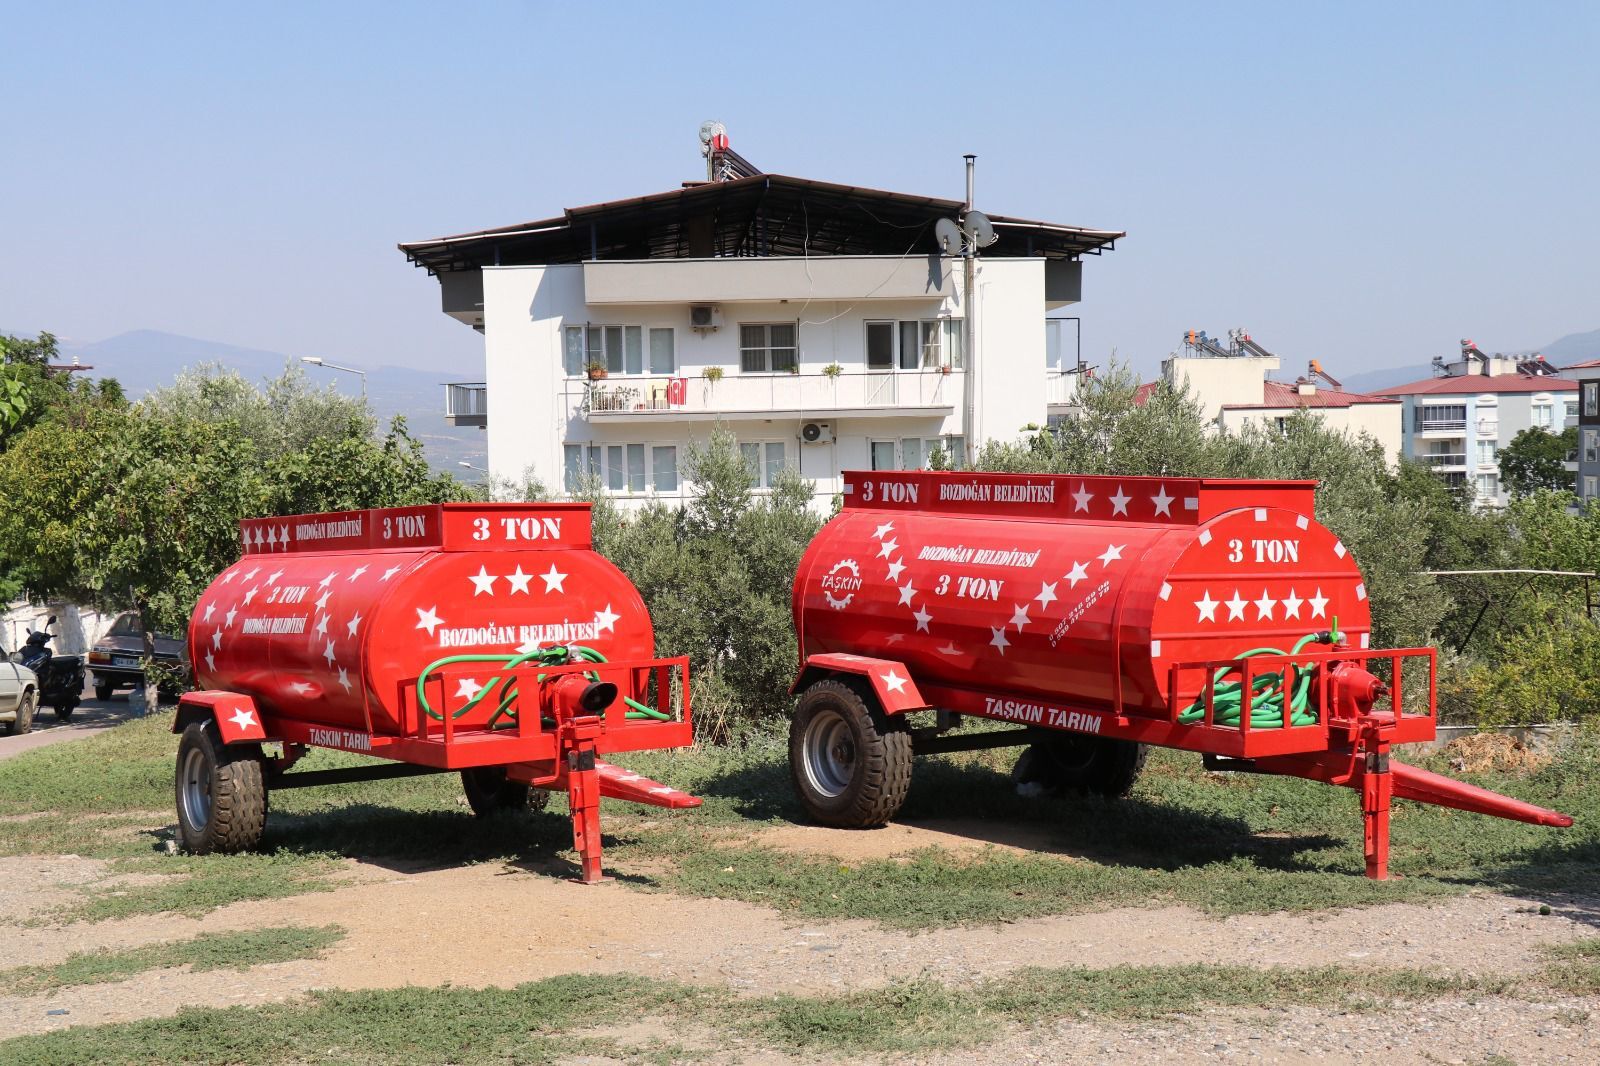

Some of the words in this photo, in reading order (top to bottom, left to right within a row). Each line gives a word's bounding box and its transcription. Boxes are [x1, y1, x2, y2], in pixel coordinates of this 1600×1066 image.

[862, 481, 874, 501] 3
[880, 482, 920, 504] TON
[940, 480, 991, 502] BOZDOĞAN
[993, 480, 1055, 504] BELEDİYESİ
[296, 520, 326, 541] BOZDOĞAN
[326, 515, 362, 539] BELEDİYESİ
[383, 517, 392, 539] 3
[395, 515, 426, 538] TON
[472, 518, 490, 541] 3
[501, 517, 562, 541] TON
[917, 544, 974, 564] BOZDOĞAN
[972, 547, 1042, 568] BELEDİYESİ
[1228, 538, 1243, 563] 3
[1252, 539, 1300, 563] TON
[266, 586, 280, 604] 3
[278, 586, 310, 604] TON
[821, 574, 863, 593] TAŞKIN
[934, 574, 951, 596] 3
[957, 576, 1005, 601] TON
[242, 615, 271, 634] BOZDOĞAN
[270, 613, 309, 634] BELEDİYESİ
[439, 621, 516, 647] BOZDOĞAN
[520, 617, 600, 644] BELEDİYESİ
[985, 697, 1044, 723] TAŞKIN
[1048, 708, 1102, 734] TARIM
[309, 728, 341, 747] TAŞKIN
[343, 732, 372, 751] TARIM
